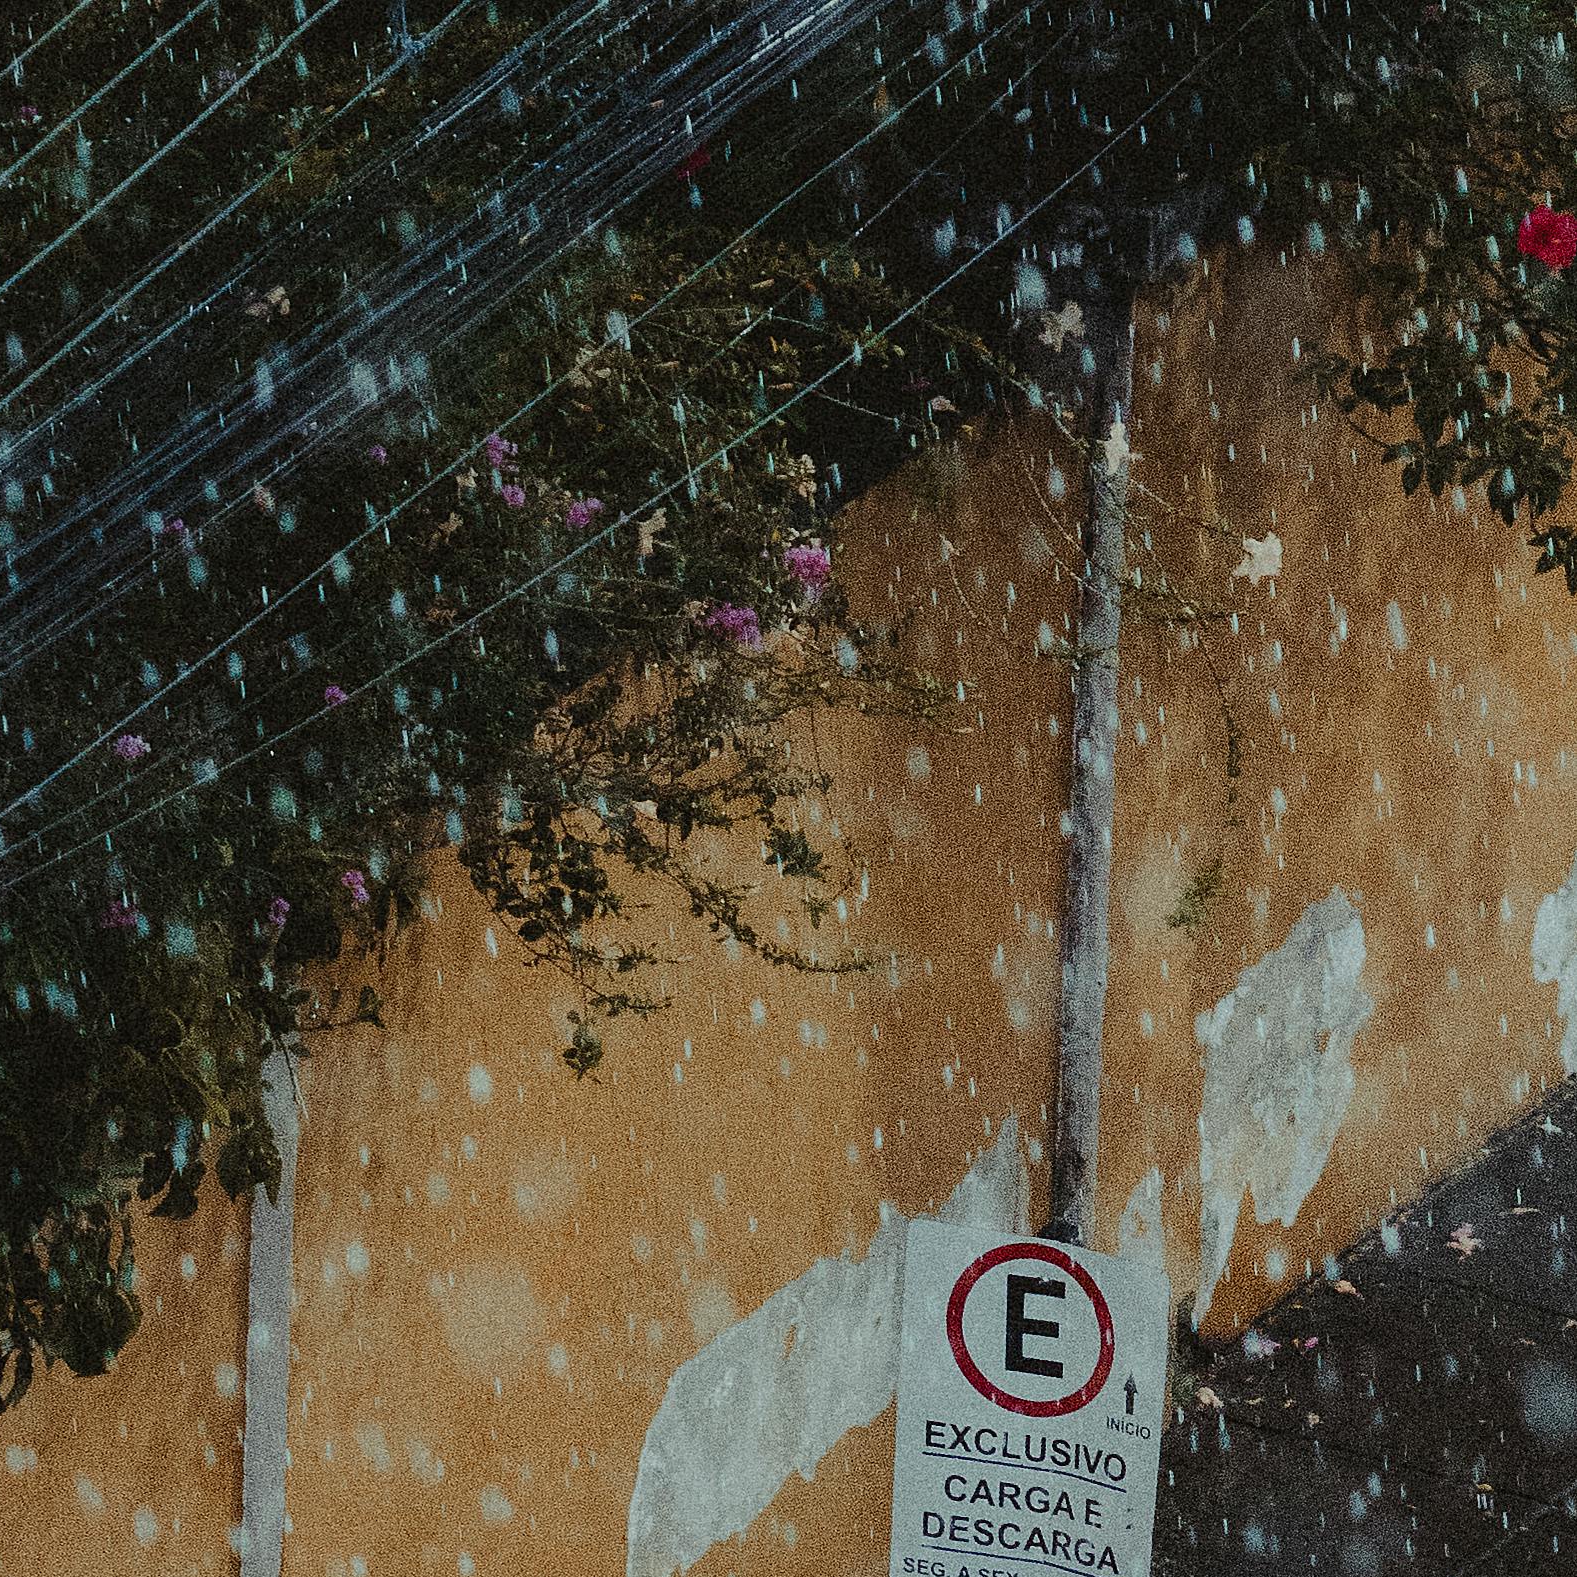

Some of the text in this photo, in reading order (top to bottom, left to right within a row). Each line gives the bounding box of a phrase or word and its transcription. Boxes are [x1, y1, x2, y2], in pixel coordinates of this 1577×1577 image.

[1005, 1274, 1066, 1379] E
[924, 1420, 1127, 1483] EXCLUSIVO
[1106, 1415, 1151, 1440] INÍCIO
[944, 1474, 1103, 1530] CARGA E
[922, 1511, 1120, 1575] DESCARGA
